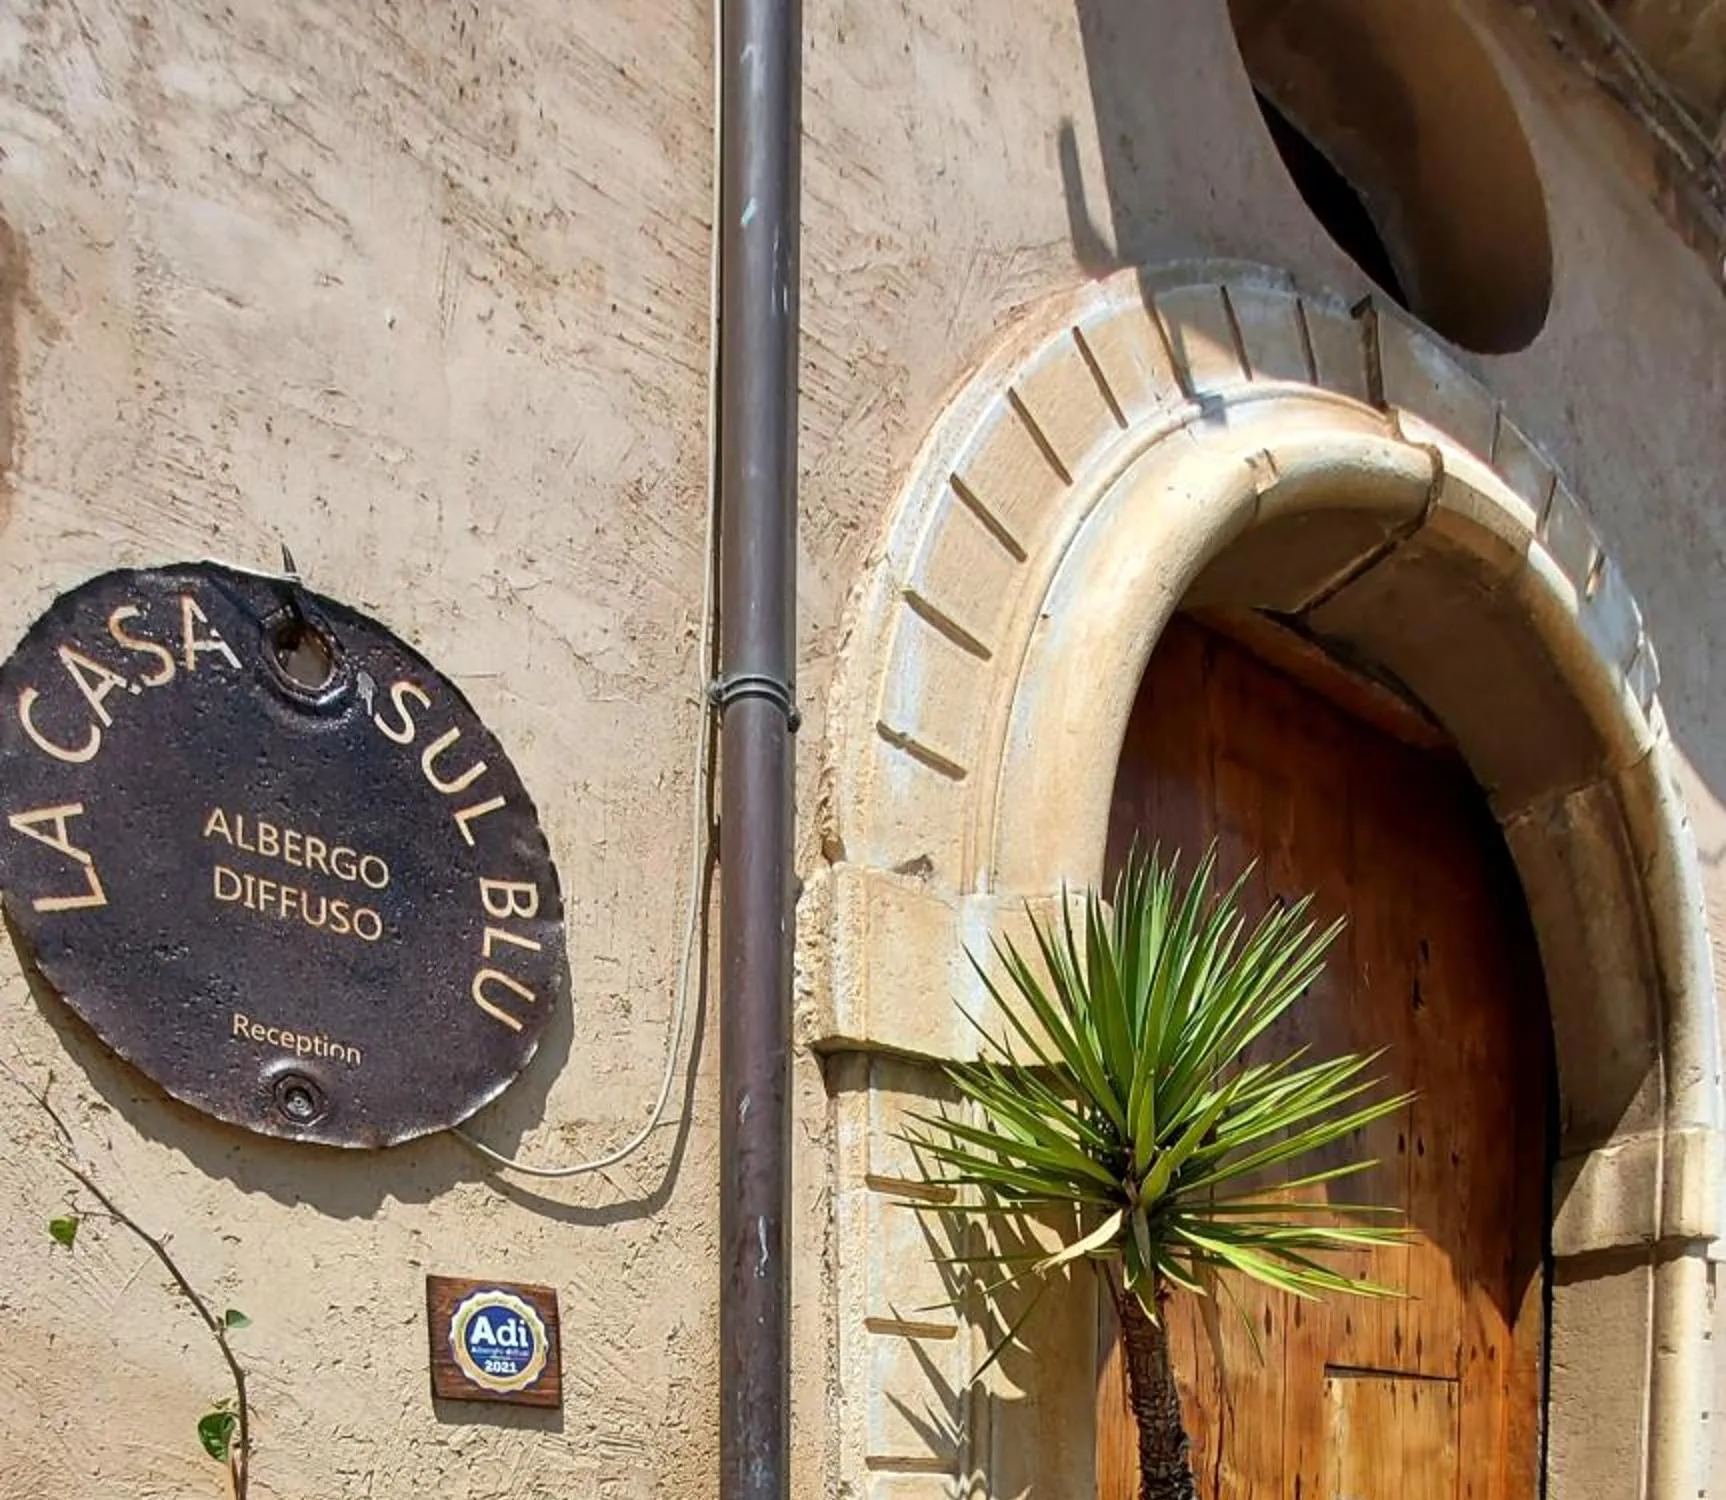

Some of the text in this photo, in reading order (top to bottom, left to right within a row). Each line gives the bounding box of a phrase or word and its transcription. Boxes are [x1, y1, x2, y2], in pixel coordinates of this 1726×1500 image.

[8, 592, 541, 1033] LA CASA SUL BLU
[203, 807, 390, 890] ALBERGO
[213, 866, 384, 943] DIFFUSO
[232, 1013, 363, 1066] Reception
[470, 1315, 529, 1347] Adi
[484, 1360, 517, 1373] 2021
